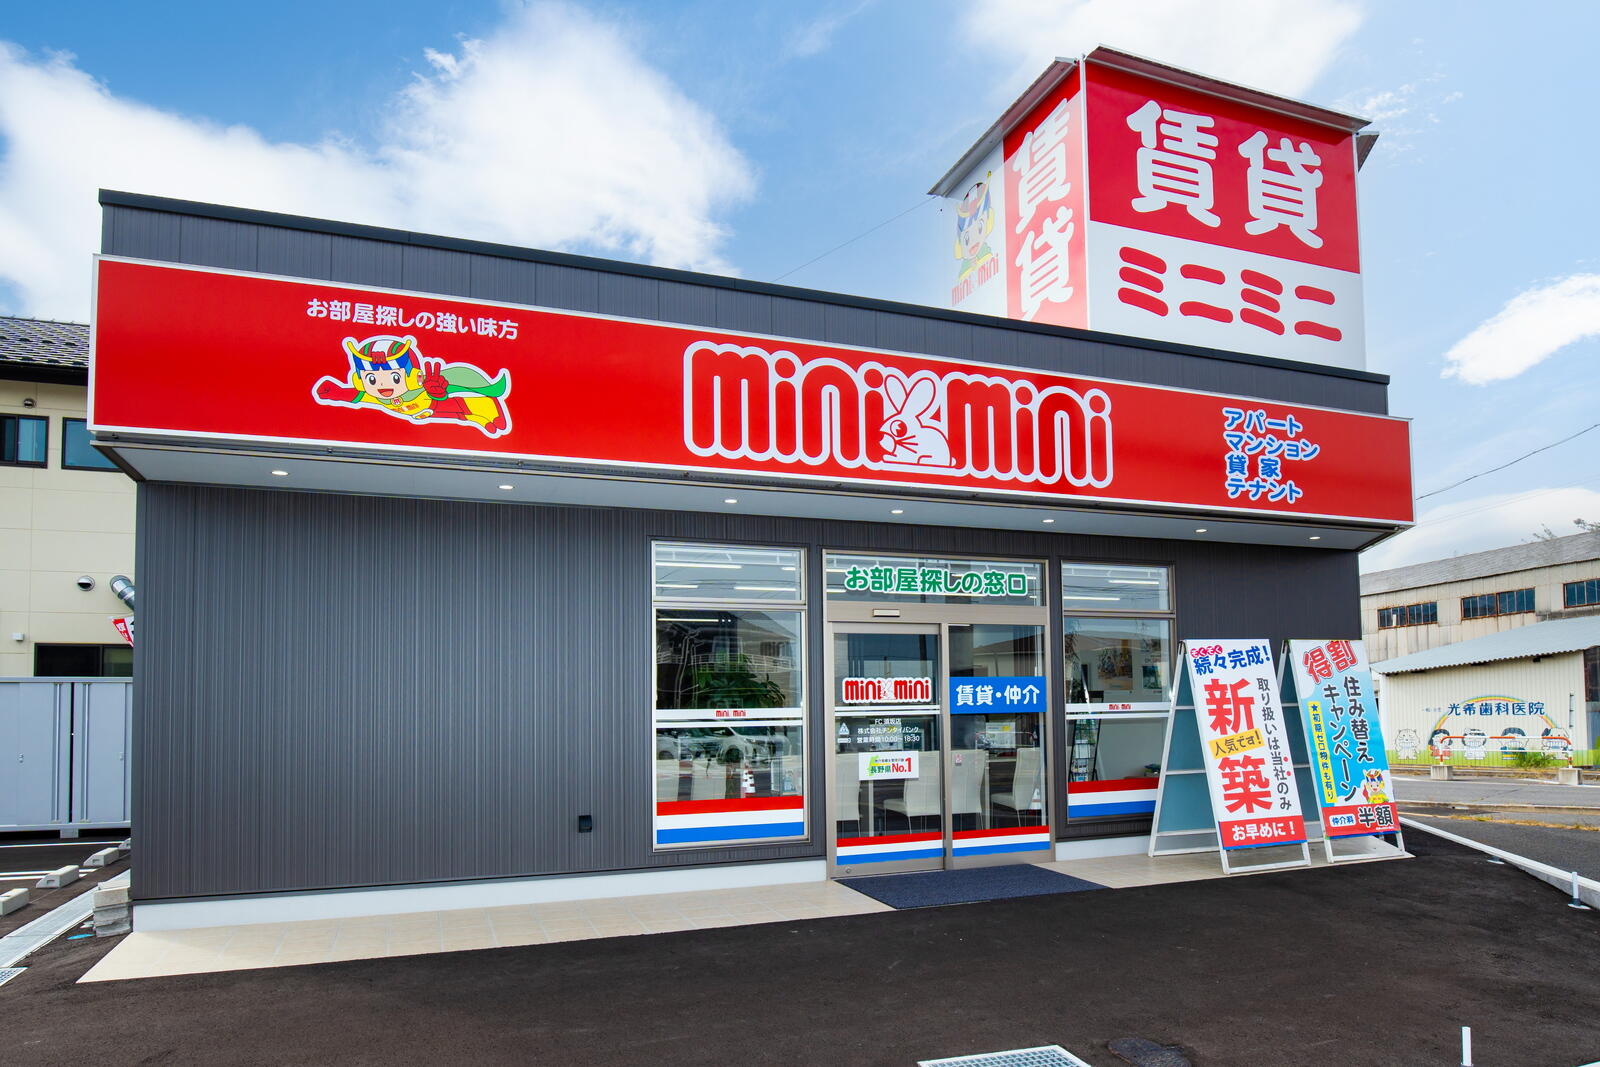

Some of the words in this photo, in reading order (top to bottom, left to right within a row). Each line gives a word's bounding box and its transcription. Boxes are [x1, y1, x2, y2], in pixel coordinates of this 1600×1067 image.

[1126, 100, 1324, 249] 賃貸
[1012, 98, 1074, 321] 賃貸
[1117, 246, 1342, 342] ミニミニ
[306, 298, 519, 340] お部屋探しの強い味方
[1222, 407, 1303, 438] アパート
[1223, 430, 1320, 461] マンション
[1225, 476, 1303, 504] テナント
[844, 566, 1028, 596] お部屋探しの窓口
[1193, 645, 1271, 676] 続々完成!
[956, 684, 1040, 706] 賃貸・仲介
[1447, 702, 1545, 716] 光希歯科医院
[1343, 676, 1374, 764] 住み替え
[1215, 730, 1262, 757] 人気です!
[1256, 677, 1292, 811] 取り扱いは当社のみ
[1323, 684, 1357, 802] キャンペーン
[1232, 820, 1296, 841] お早めに!
[1358, 805, 1394, 829] 半額
